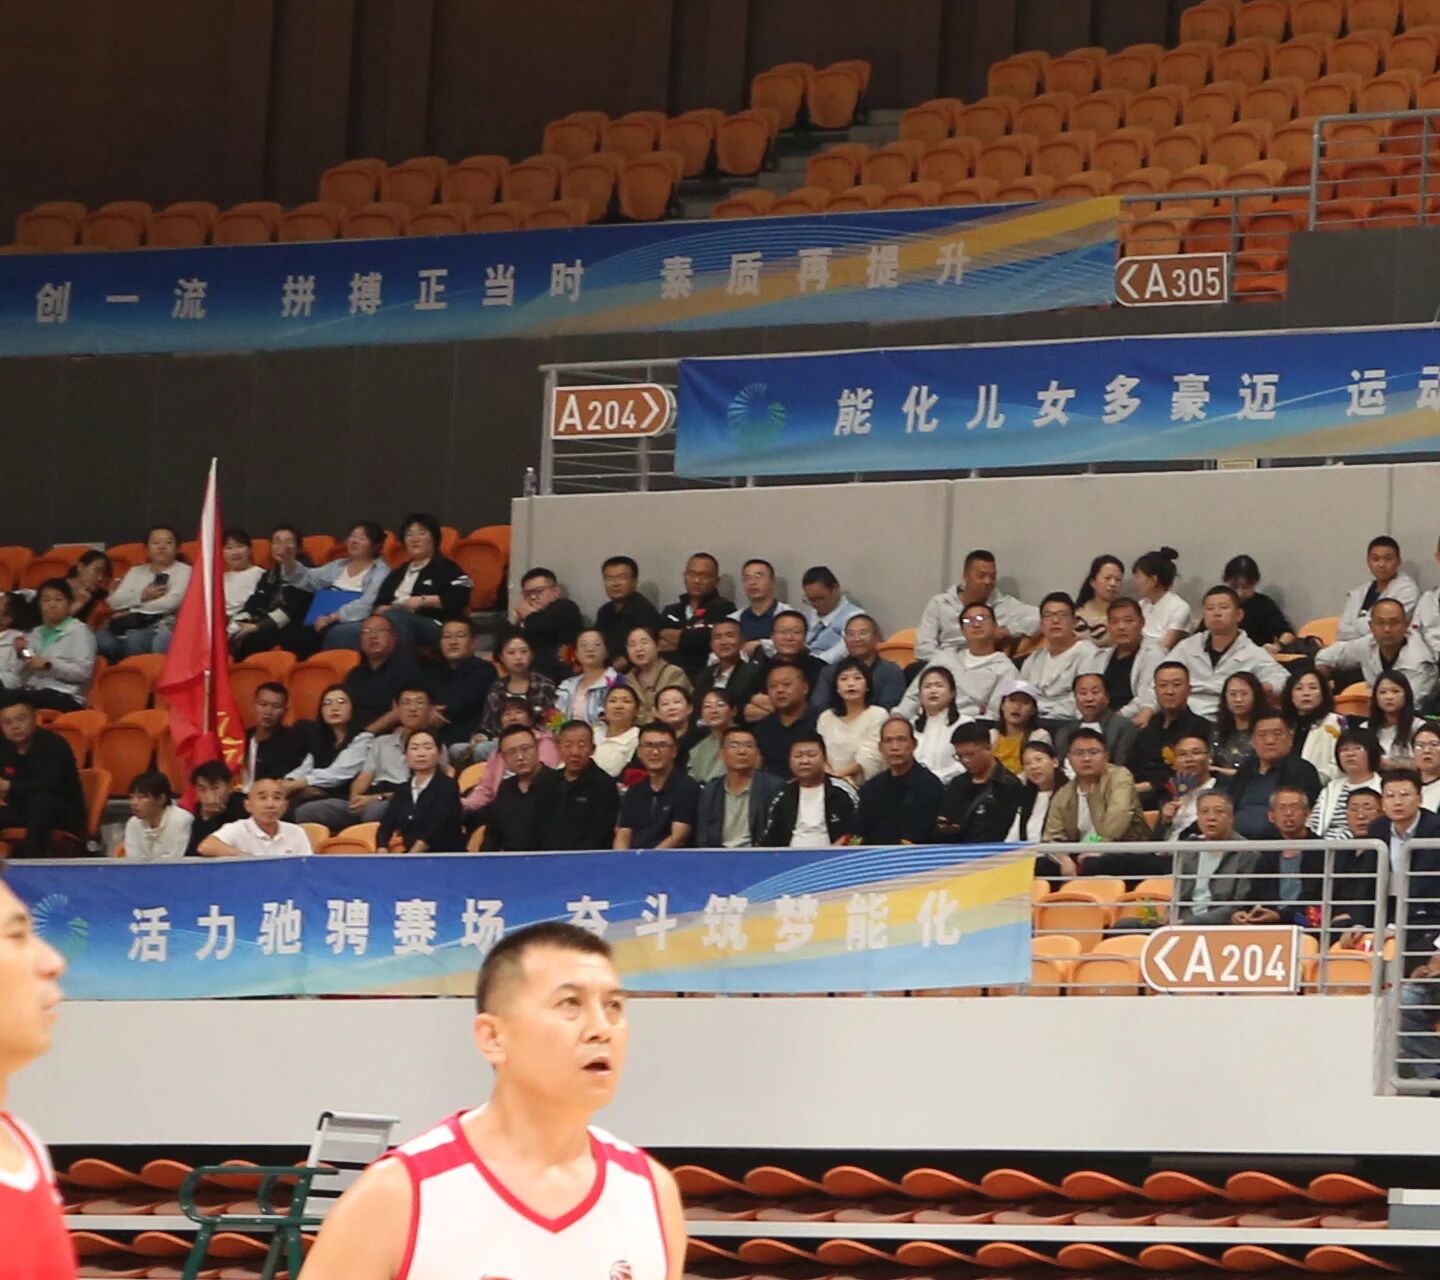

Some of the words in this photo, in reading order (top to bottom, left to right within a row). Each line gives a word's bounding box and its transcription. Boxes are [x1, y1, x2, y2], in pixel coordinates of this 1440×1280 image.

[1142, 261, 1222, 300] A305
[556, 389, 638, 434] A204
[833, 373, 1280, 436] 能化儿女多豪迈
[1184, 935, 1288, 981] A204
